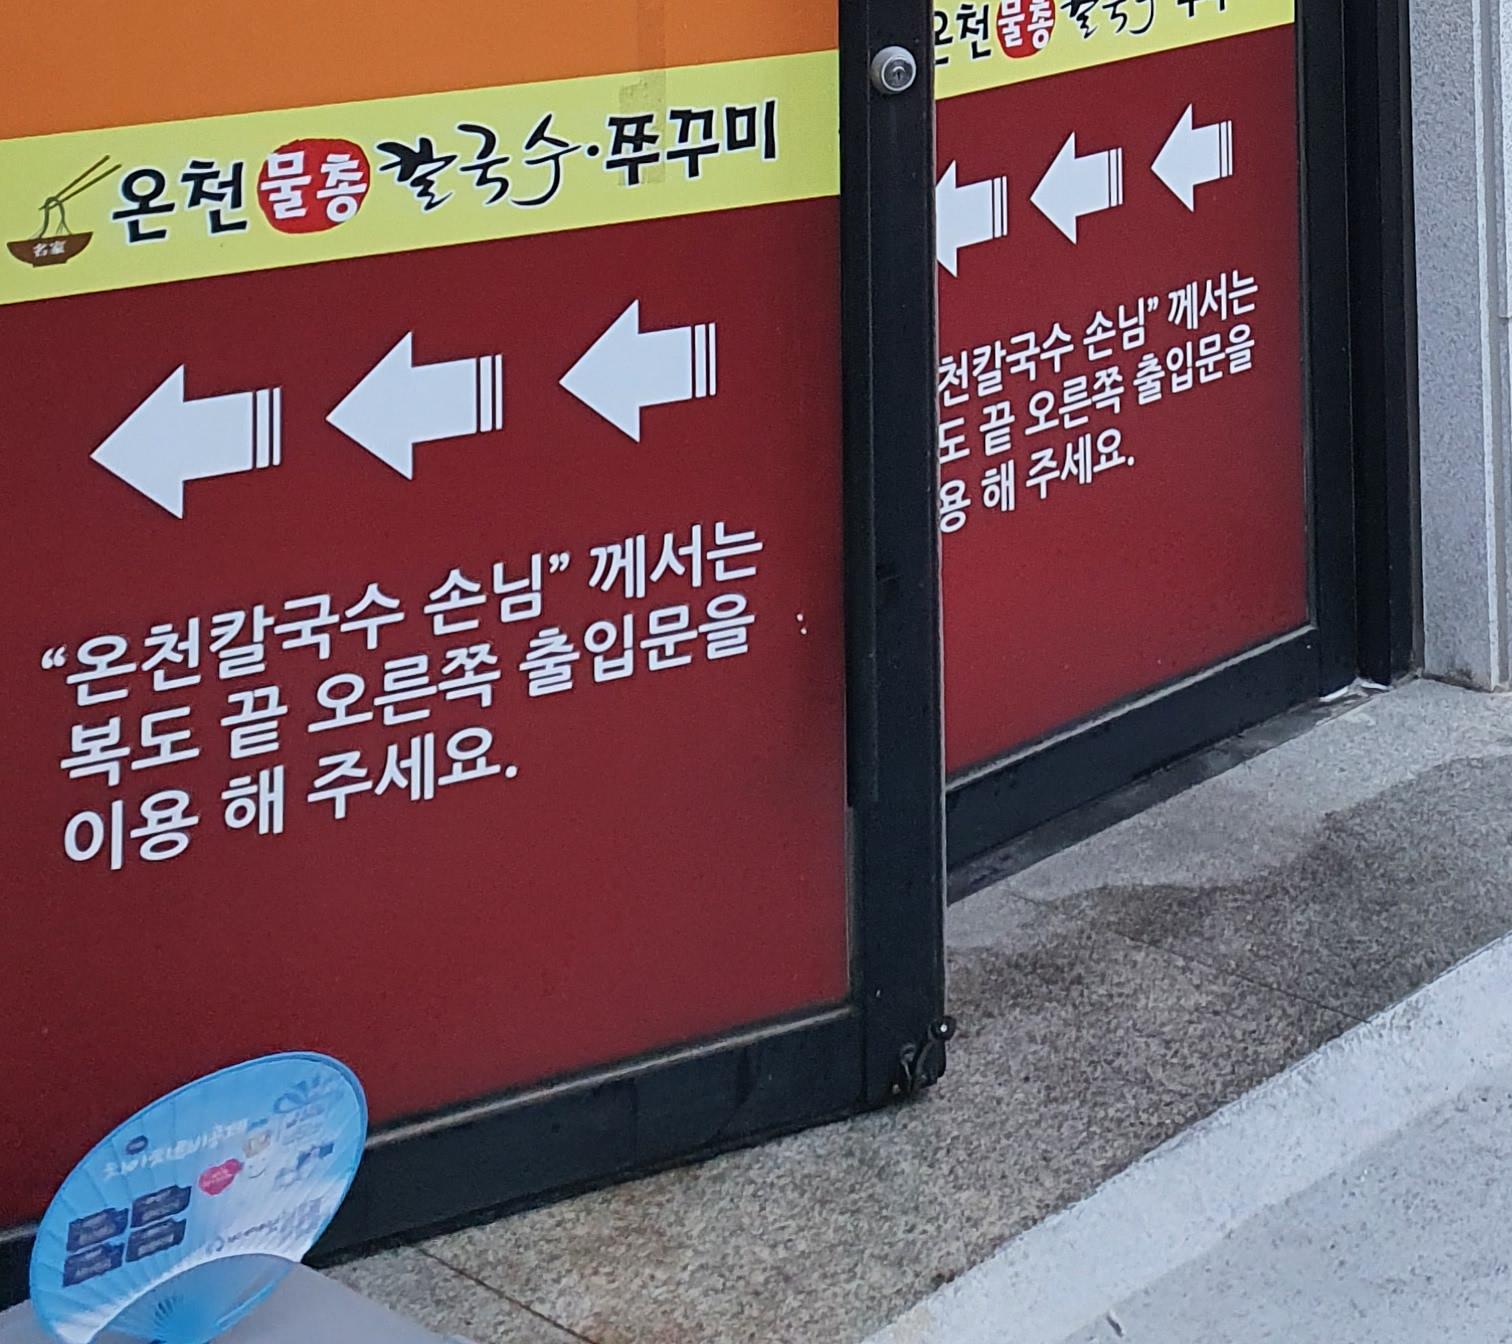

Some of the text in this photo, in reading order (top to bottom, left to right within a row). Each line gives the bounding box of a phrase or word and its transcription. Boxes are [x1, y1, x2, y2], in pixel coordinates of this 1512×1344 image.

[111, 153, 251, 243] 온천
[258, 148, 369, 222] 물총
[1167, 269, 1258, 331] 께서는
[979, 400, 1015, 457] 끝
[1024, 369, 1125, 436] 오른쪽
[1133, 322, 1255, 406] 출입문을
[938, 428, 1136, 534] 용 해 주세요.
[40, 520, 766, 708] “온천칼국수 손님” 께서는
[60, 592, 757, 787] 복도 끝 오른쪽 출입문을
[63, 725, 520, 872] 이용 해 주세요.
